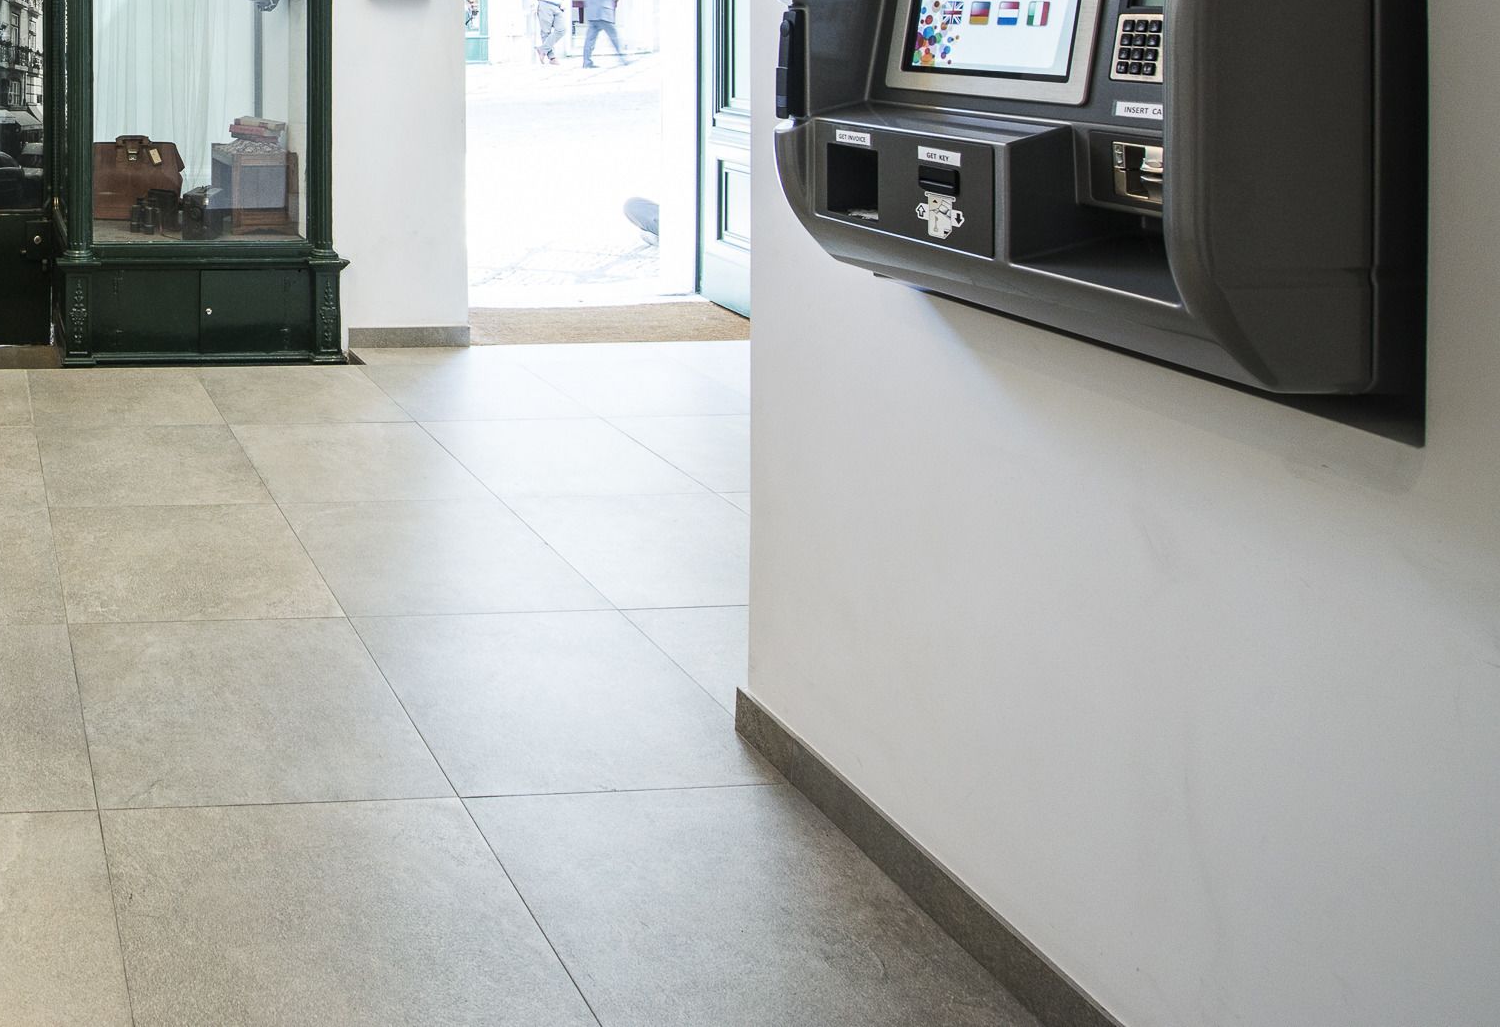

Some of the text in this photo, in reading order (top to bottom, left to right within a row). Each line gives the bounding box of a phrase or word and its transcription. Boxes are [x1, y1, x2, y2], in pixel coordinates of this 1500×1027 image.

[1124, 106, 1149, 114] INSERT
[848, 135, 866, 143] INVOICE
[926, 152, 949, 162] GET KEY
